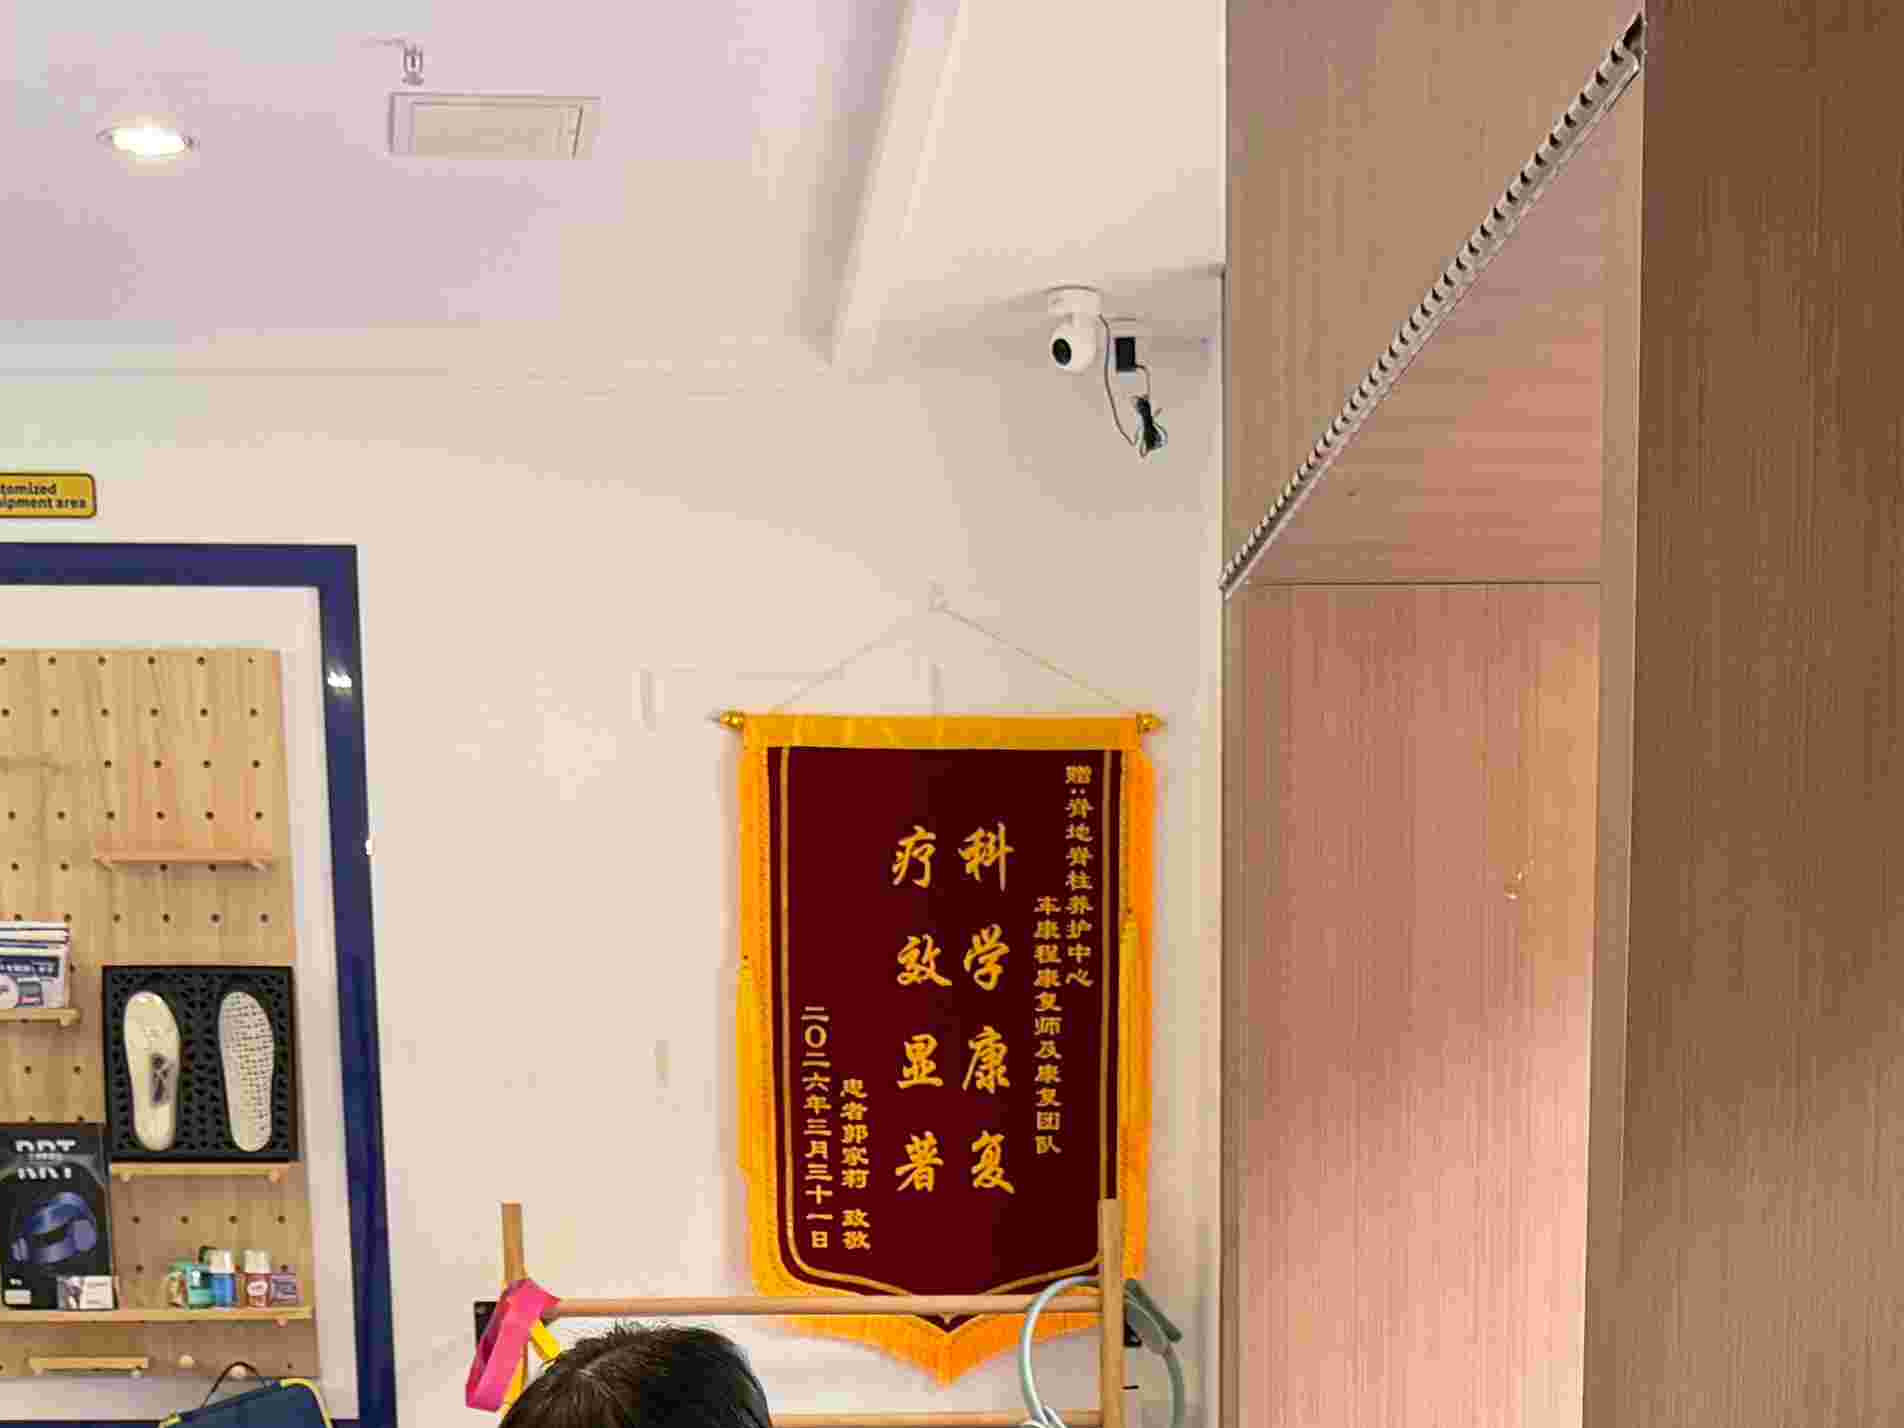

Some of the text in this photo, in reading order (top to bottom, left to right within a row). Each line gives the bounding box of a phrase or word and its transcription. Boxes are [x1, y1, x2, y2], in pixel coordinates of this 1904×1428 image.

[891, 824, 953, 1194] 疗效显著
[957, 820, 1017, 1196] 科学康复
